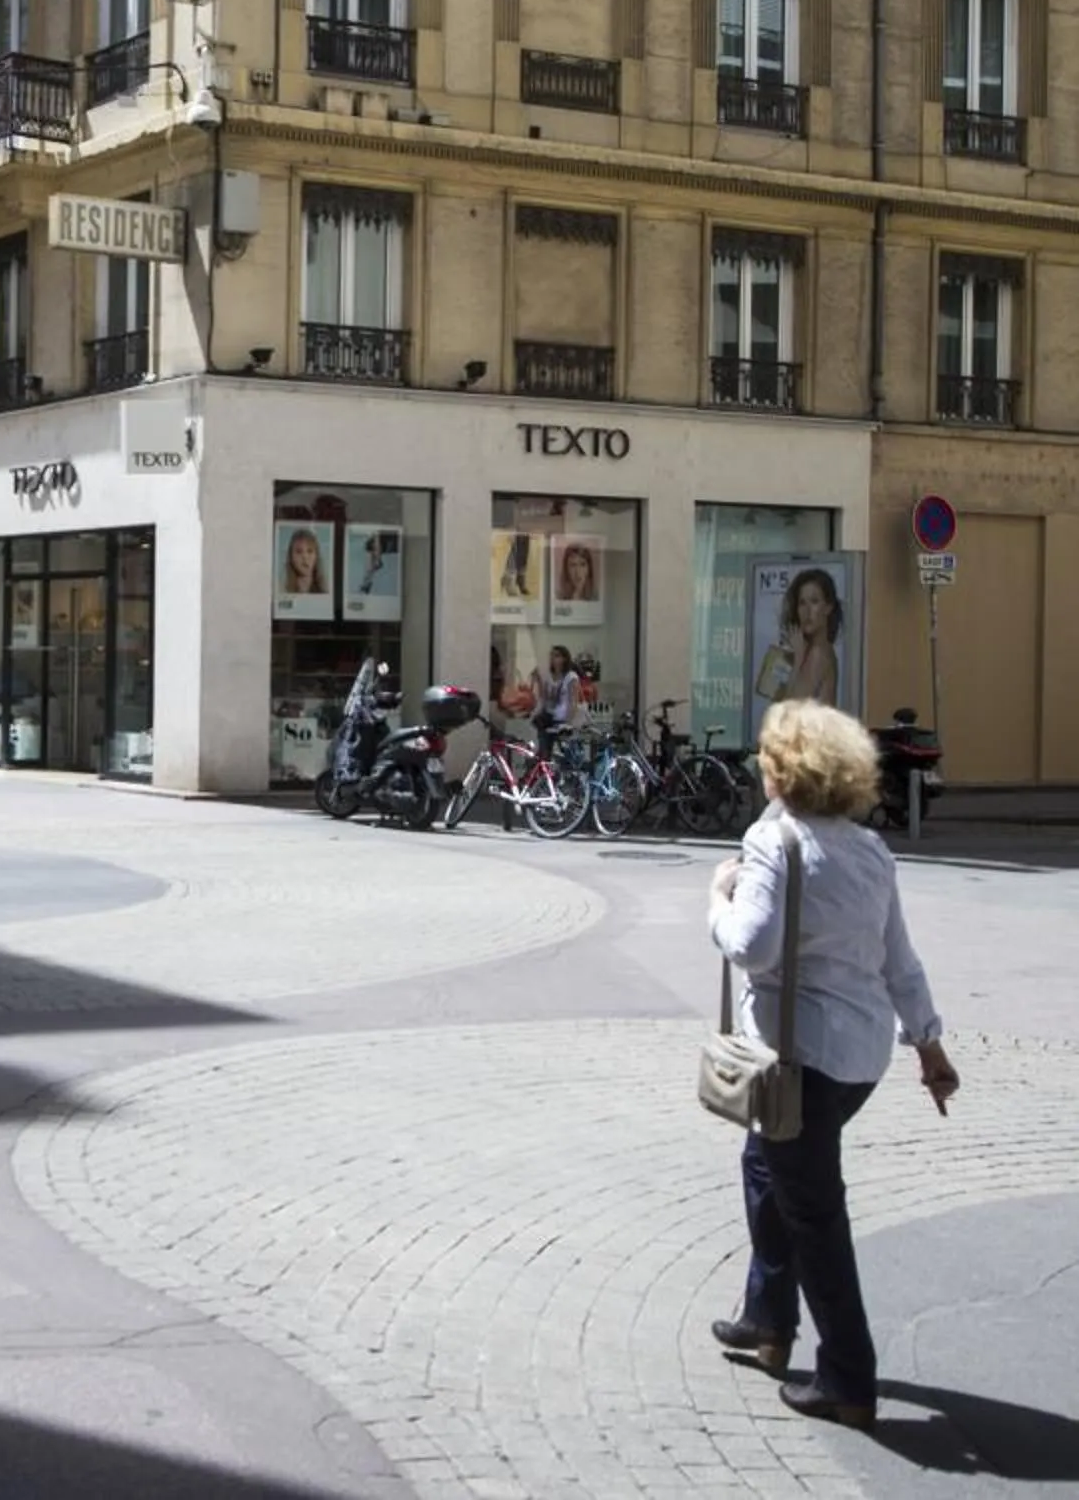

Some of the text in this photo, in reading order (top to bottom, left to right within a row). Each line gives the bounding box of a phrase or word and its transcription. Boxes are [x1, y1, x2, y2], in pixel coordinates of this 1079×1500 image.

[59, 201, 184, 254] RESIDENCE
[133, 451, 183, 468] TEXTO
[515, 422, 630, 460] TEXTO
[8, 460, 79, 496] TEXTO
